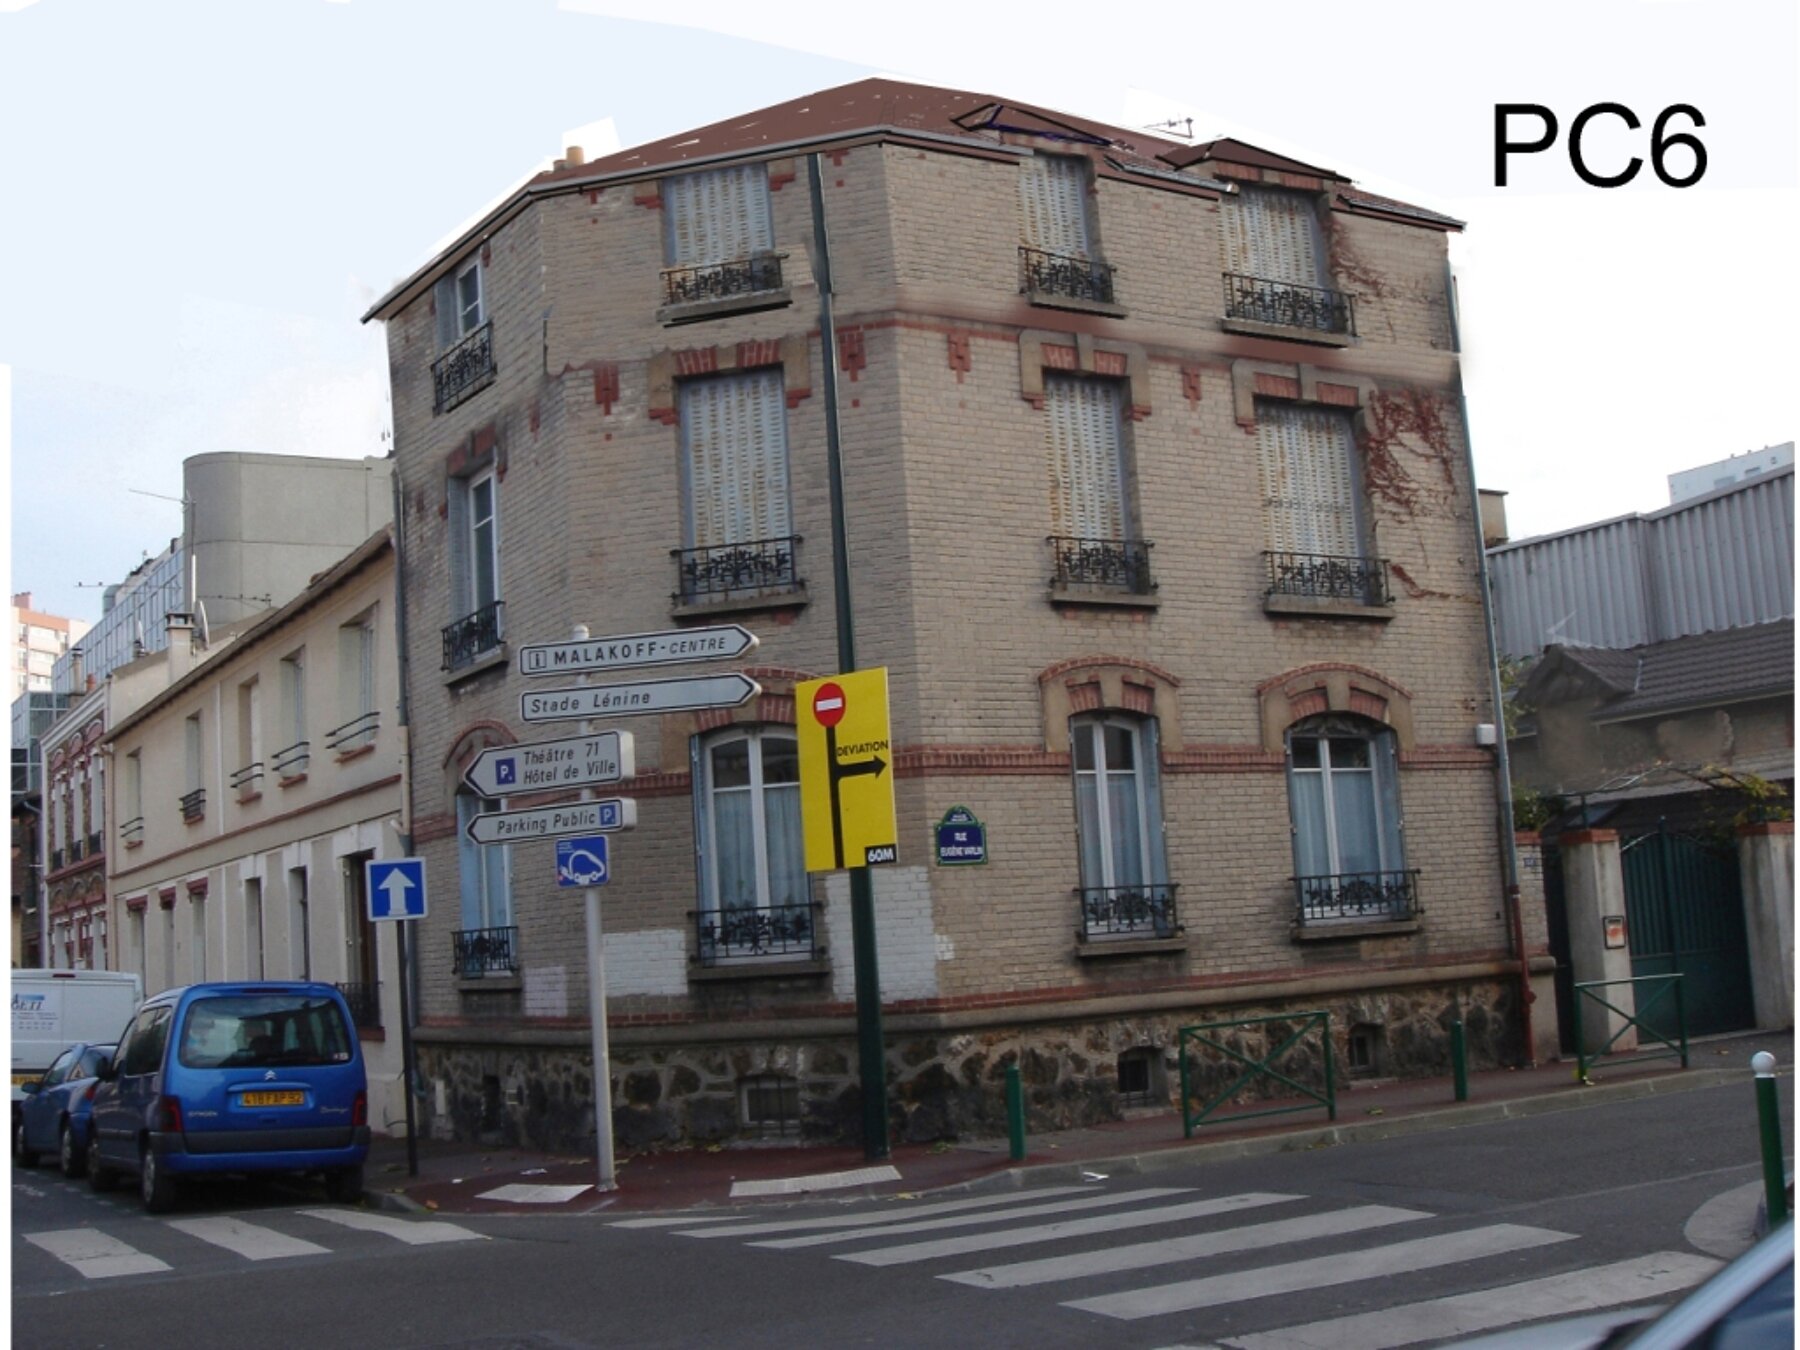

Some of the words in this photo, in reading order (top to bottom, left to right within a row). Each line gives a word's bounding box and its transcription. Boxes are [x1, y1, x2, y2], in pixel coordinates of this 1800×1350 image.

[531, 698, 580, 714] Stade
[593, 691, 651, 708] Lénine
[523, 749, 574, 766] Théâtre
[586, 742, 599, 757] 71
[837, 740, 889, 757] DEVIATION
[523, 766, 557, 785] Hôtel
[564, 764, 579, 780] de
[587, 760, 616, 777] Ville
[497, 816, 547, 835] Parking
[553, 811, 596, 829] Public
[867, 848, 894, 863] 60M
